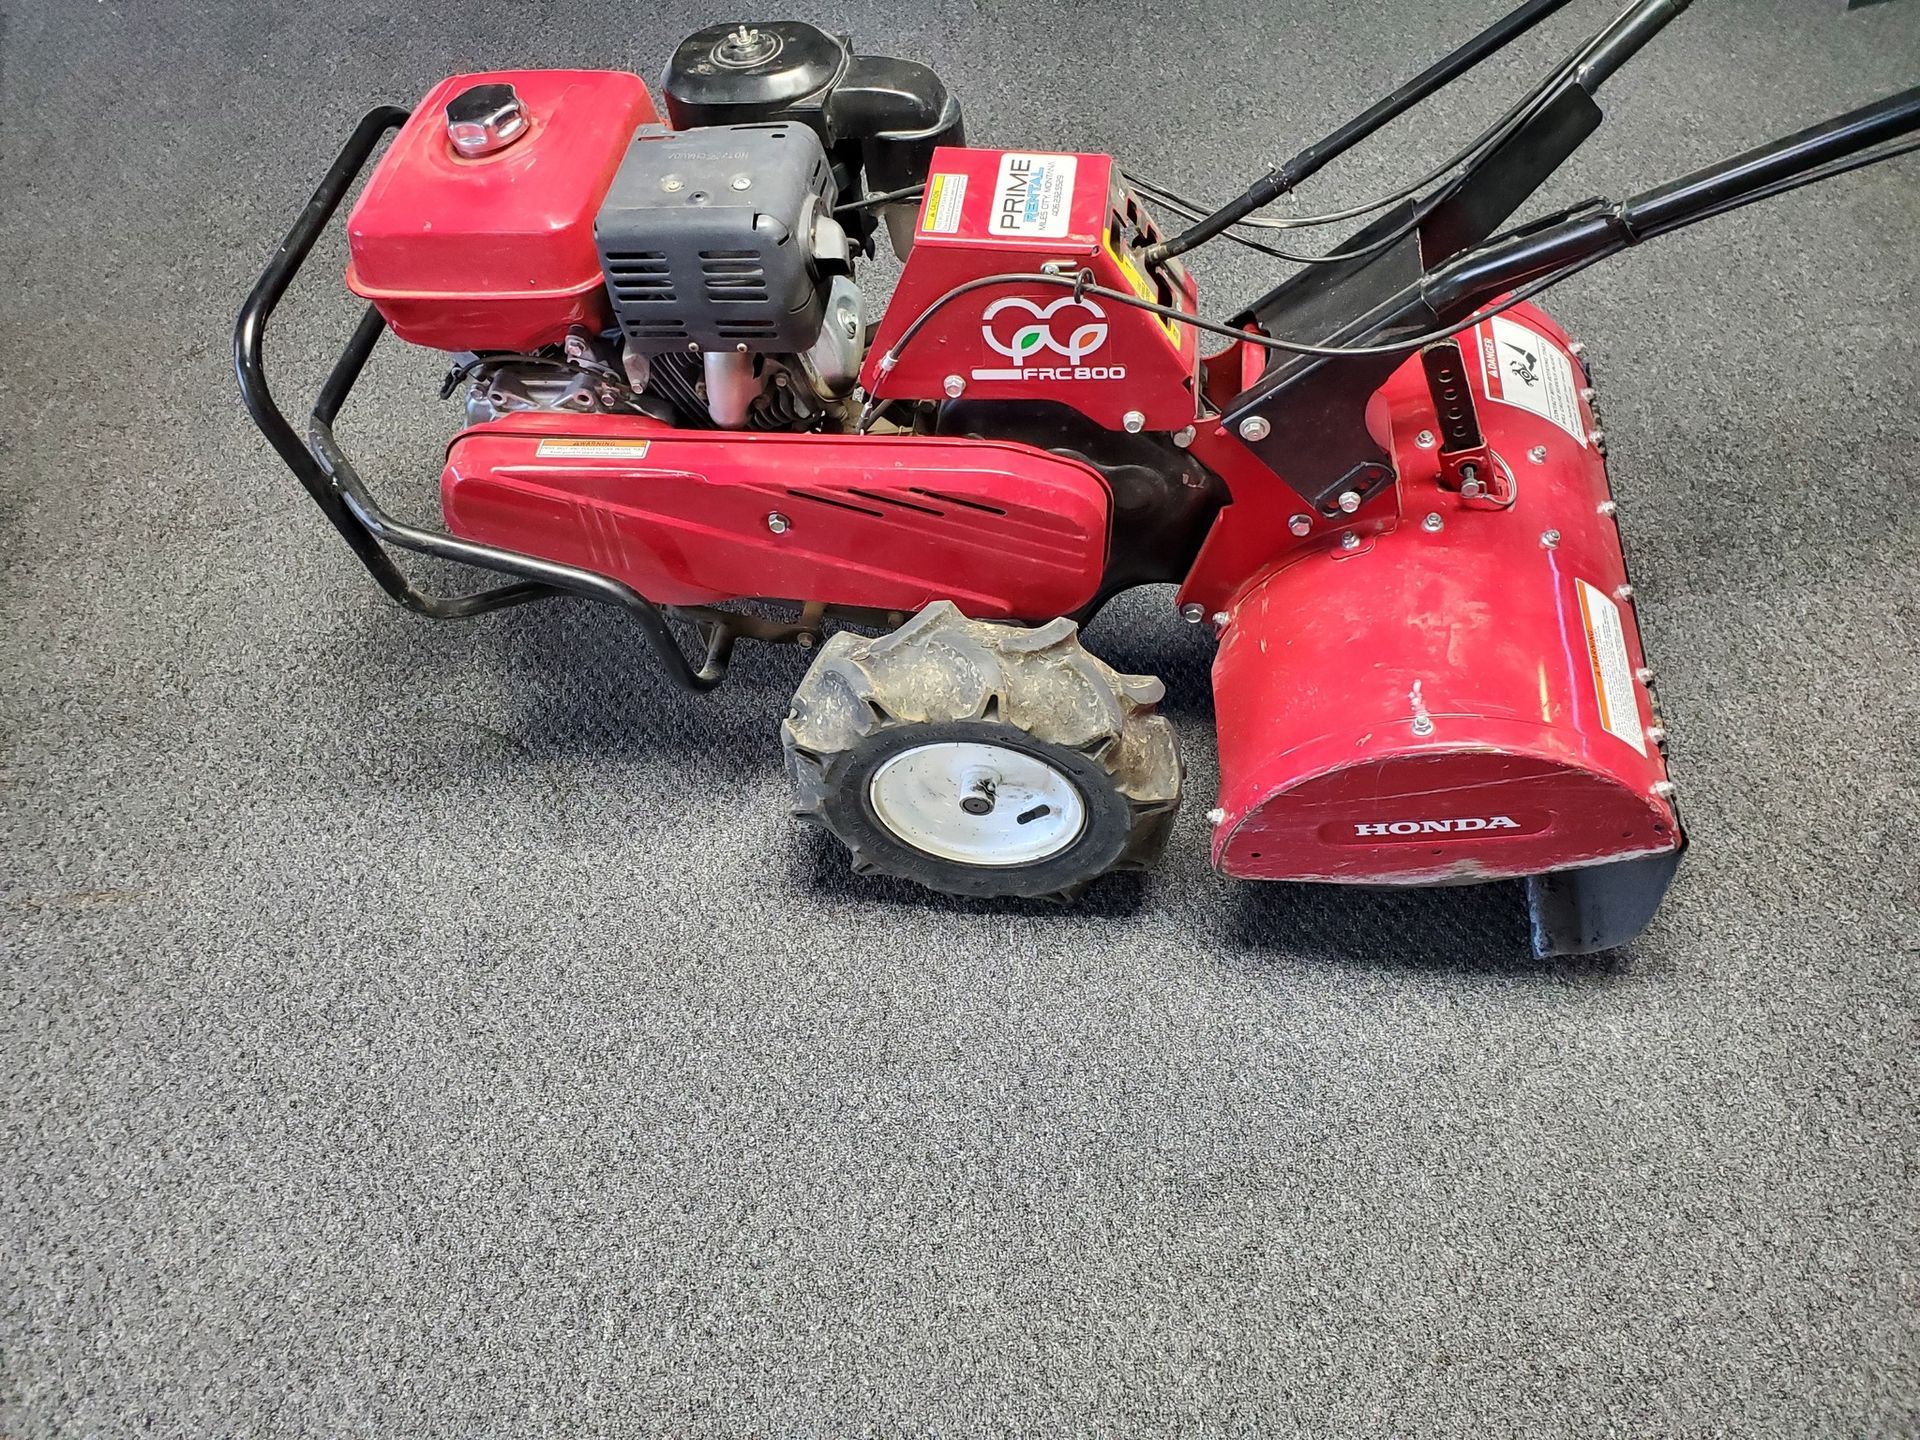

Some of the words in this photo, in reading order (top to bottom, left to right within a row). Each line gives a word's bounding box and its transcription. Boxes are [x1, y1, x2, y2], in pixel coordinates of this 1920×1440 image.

[929, 190, 939, 210] CAUTION
[1000, 159, 1031, 229] PRIME
[1023, 167, 1044, 222] RENTAL
[1039, 210, 1048, 230] MILES
[1044, 161, 1056, 192] MONTANA
[1483, 337, 1497, 370] DANGER
[1024, 367, 1125, 380] FRC800
[1550, 394, 1559, 421] CONTACT
[1354, 816, 1521, 836] HONDA
